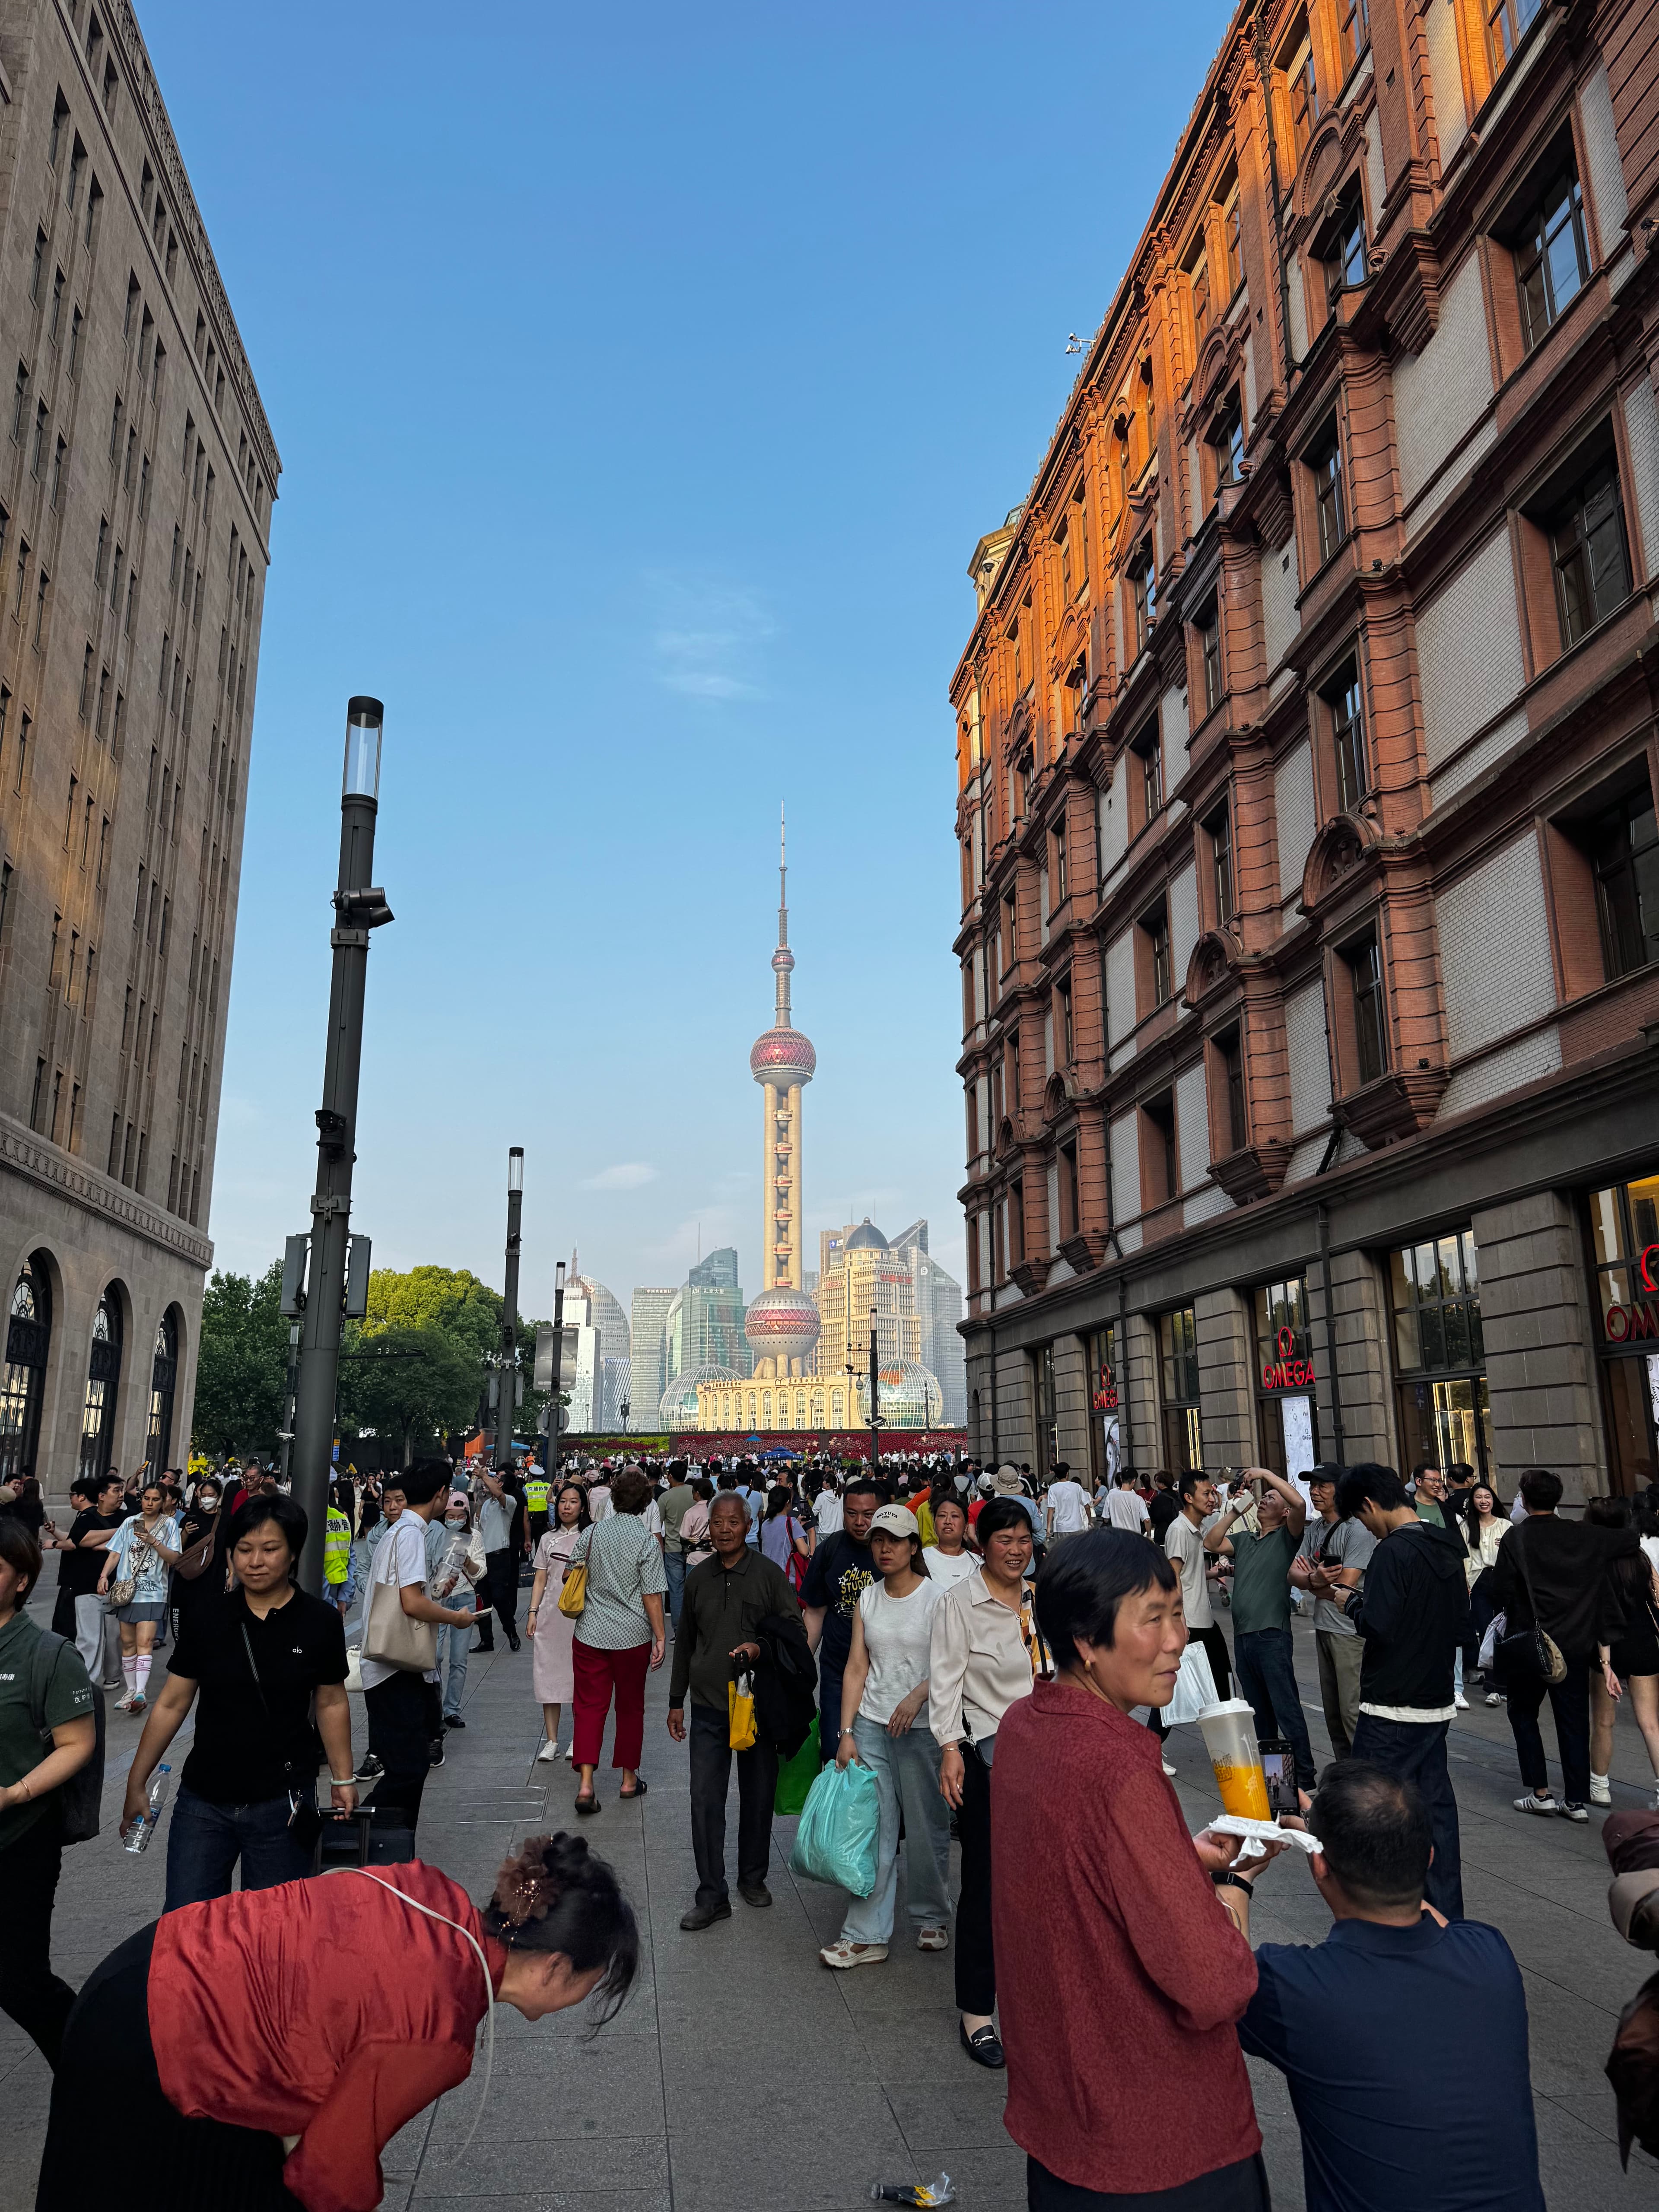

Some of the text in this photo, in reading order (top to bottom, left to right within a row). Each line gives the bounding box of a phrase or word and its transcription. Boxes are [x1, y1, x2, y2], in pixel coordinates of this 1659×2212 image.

[1606, 1300, 1659, 1342] OM
[1264, 1358, 1316, 1389] OMEGA
[1093, 1389, 1118, 1409] OMEGA
[327, 1519, 349, 1532] 通协管
[844, 1570, 871, 1582] CHLMS
[841, 1579, 873, 1594] STUDIO
